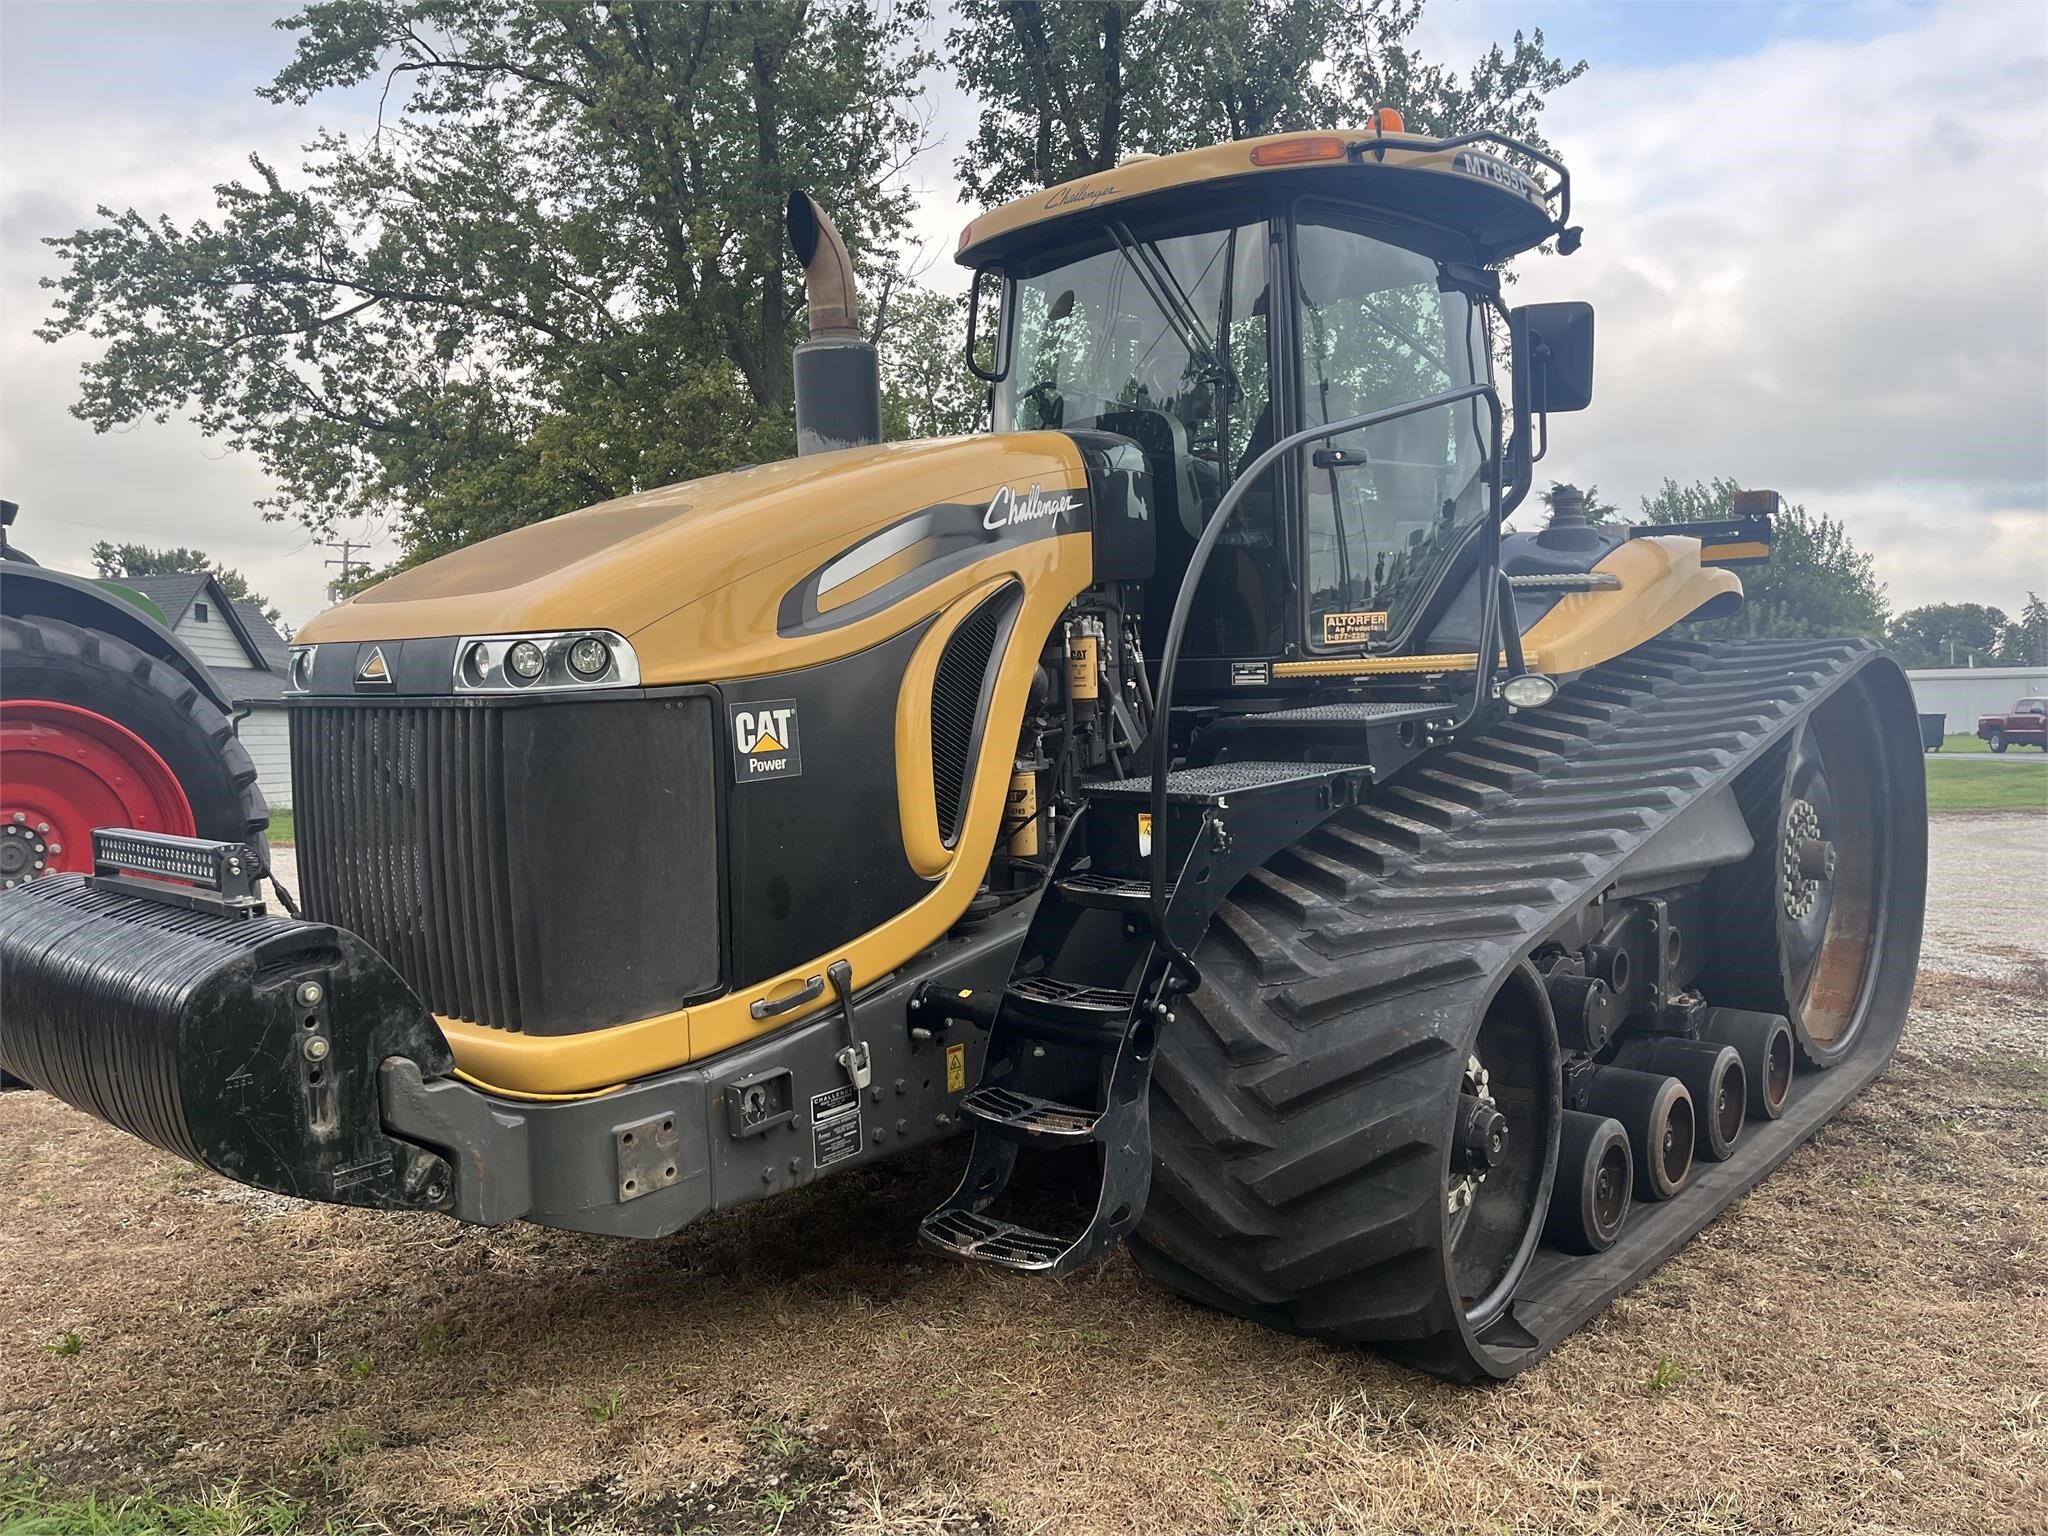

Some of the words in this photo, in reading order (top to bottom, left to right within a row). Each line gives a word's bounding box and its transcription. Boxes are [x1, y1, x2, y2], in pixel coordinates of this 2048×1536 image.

[1044, 184, 1125, 210] Challenger
[983, 484, 1084, 530] Challenger
[1327, 615, 1385, 627] ALTORFER
[1335, 626, 1346, 634] Ag
[1071, 650, 1087, 660] CAT
[735, 708, 791, 754] CAT
[749, 758, 787, 773] Power
